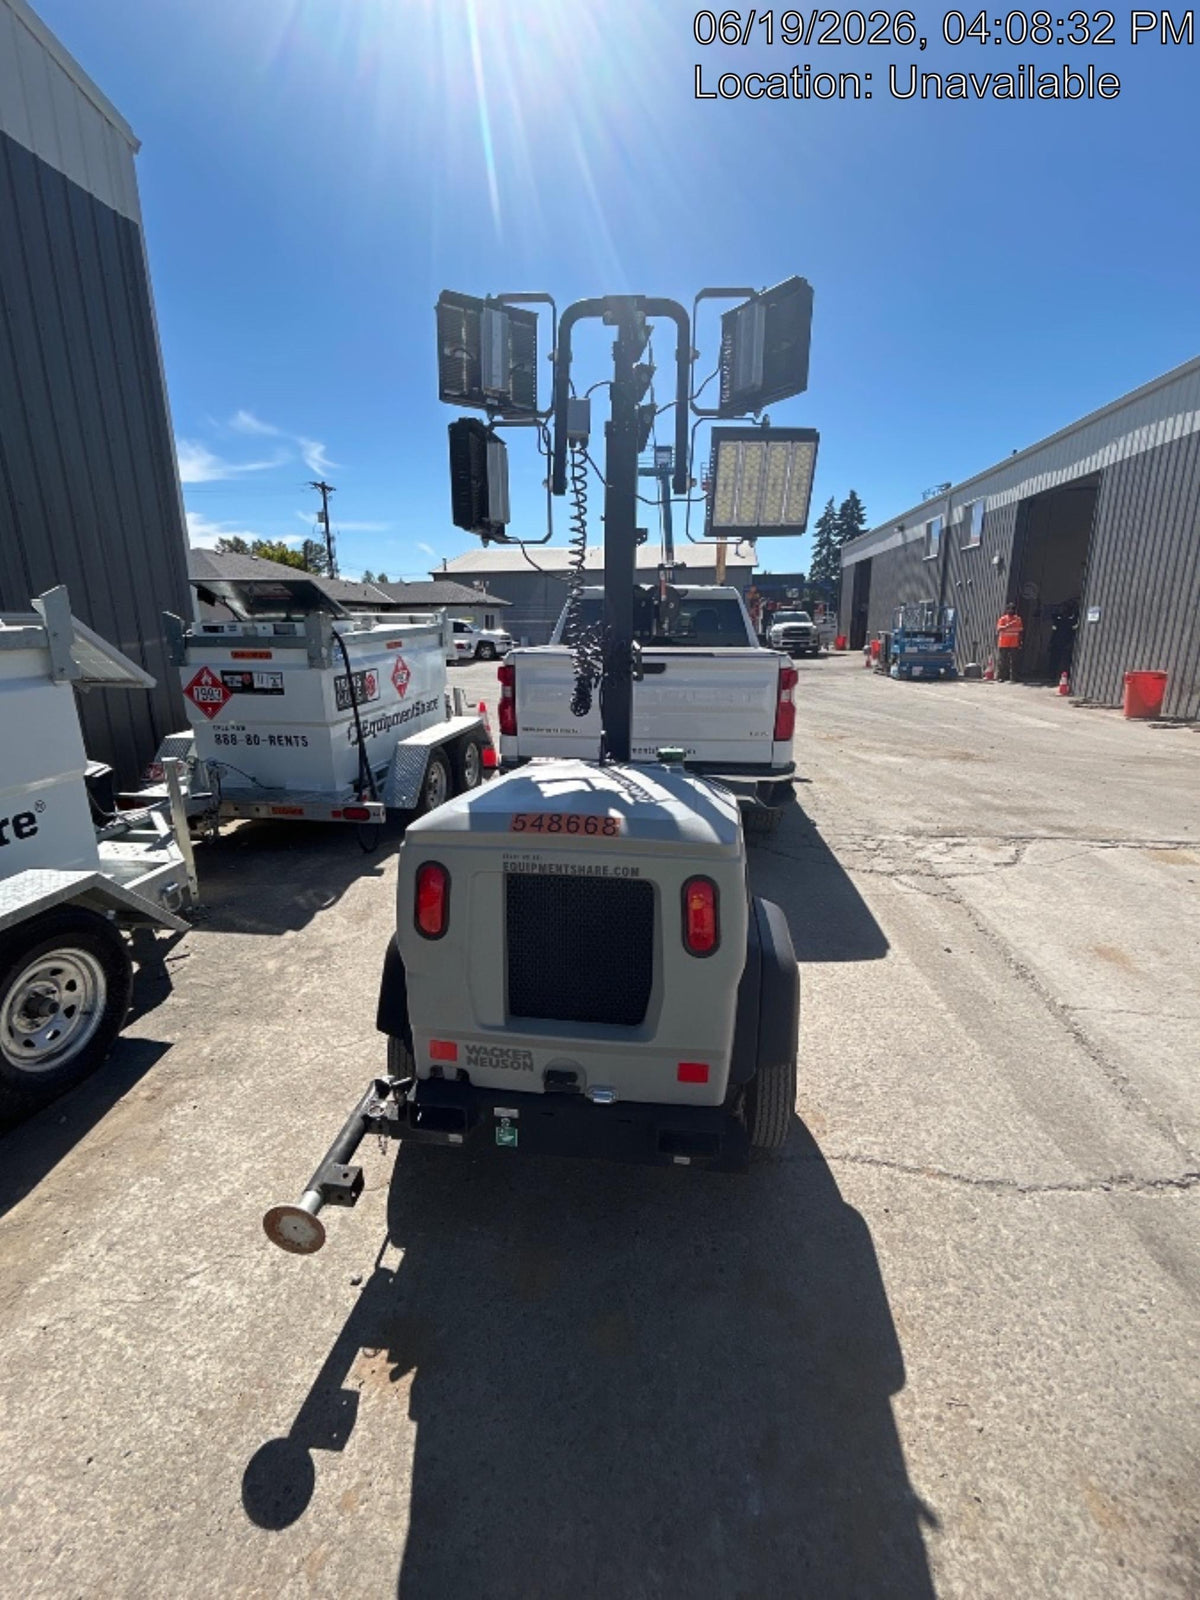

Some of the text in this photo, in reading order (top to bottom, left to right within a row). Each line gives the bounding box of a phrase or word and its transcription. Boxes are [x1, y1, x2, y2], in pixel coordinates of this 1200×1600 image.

[512, 813, 617, 836] 548668
[503, 862, 640, 877] EQUIPMENTSHARE.COM
[465, 1045, 532, 1061] WACKER
[467, 1056, 534, 1072] NEUSON
